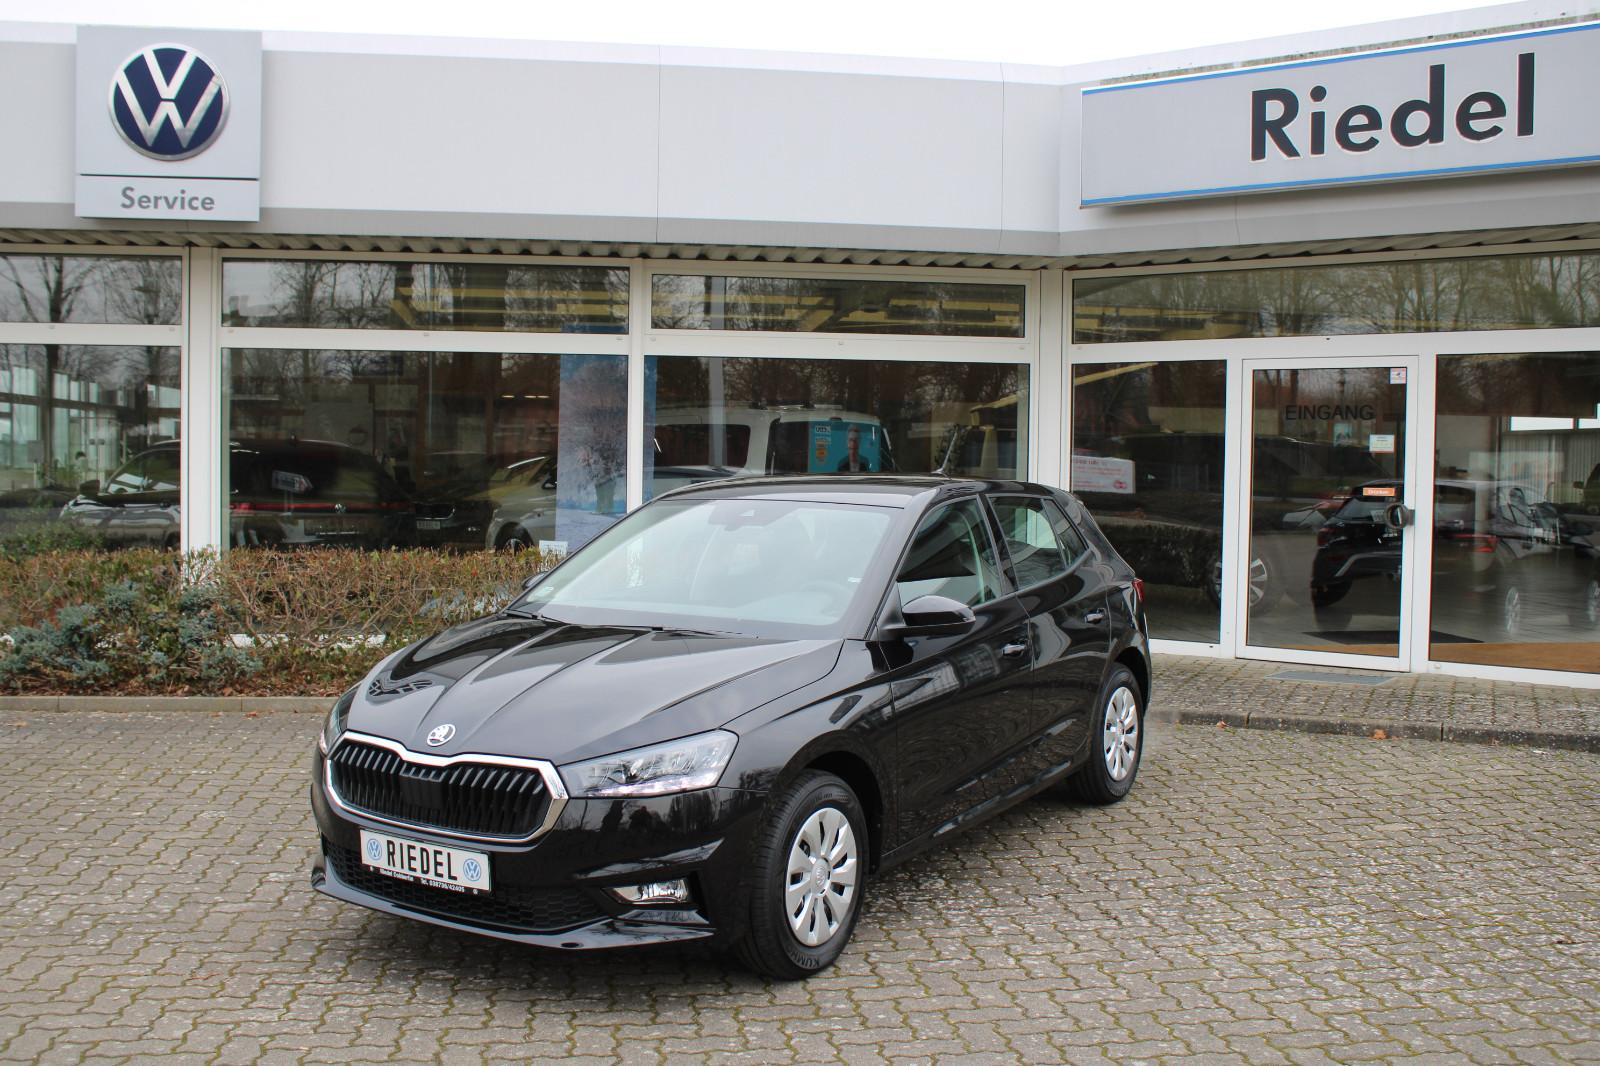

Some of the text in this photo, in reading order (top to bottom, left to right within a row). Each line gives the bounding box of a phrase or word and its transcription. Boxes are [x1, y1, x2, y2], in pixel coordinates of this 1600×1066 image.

[1251, 52, 1535, 161] Riedel
[120, 186, 215, 211] Service
[1285, 404, 1375, 420] EINGANG
[387, 840, 457, 881] RIEDEL
